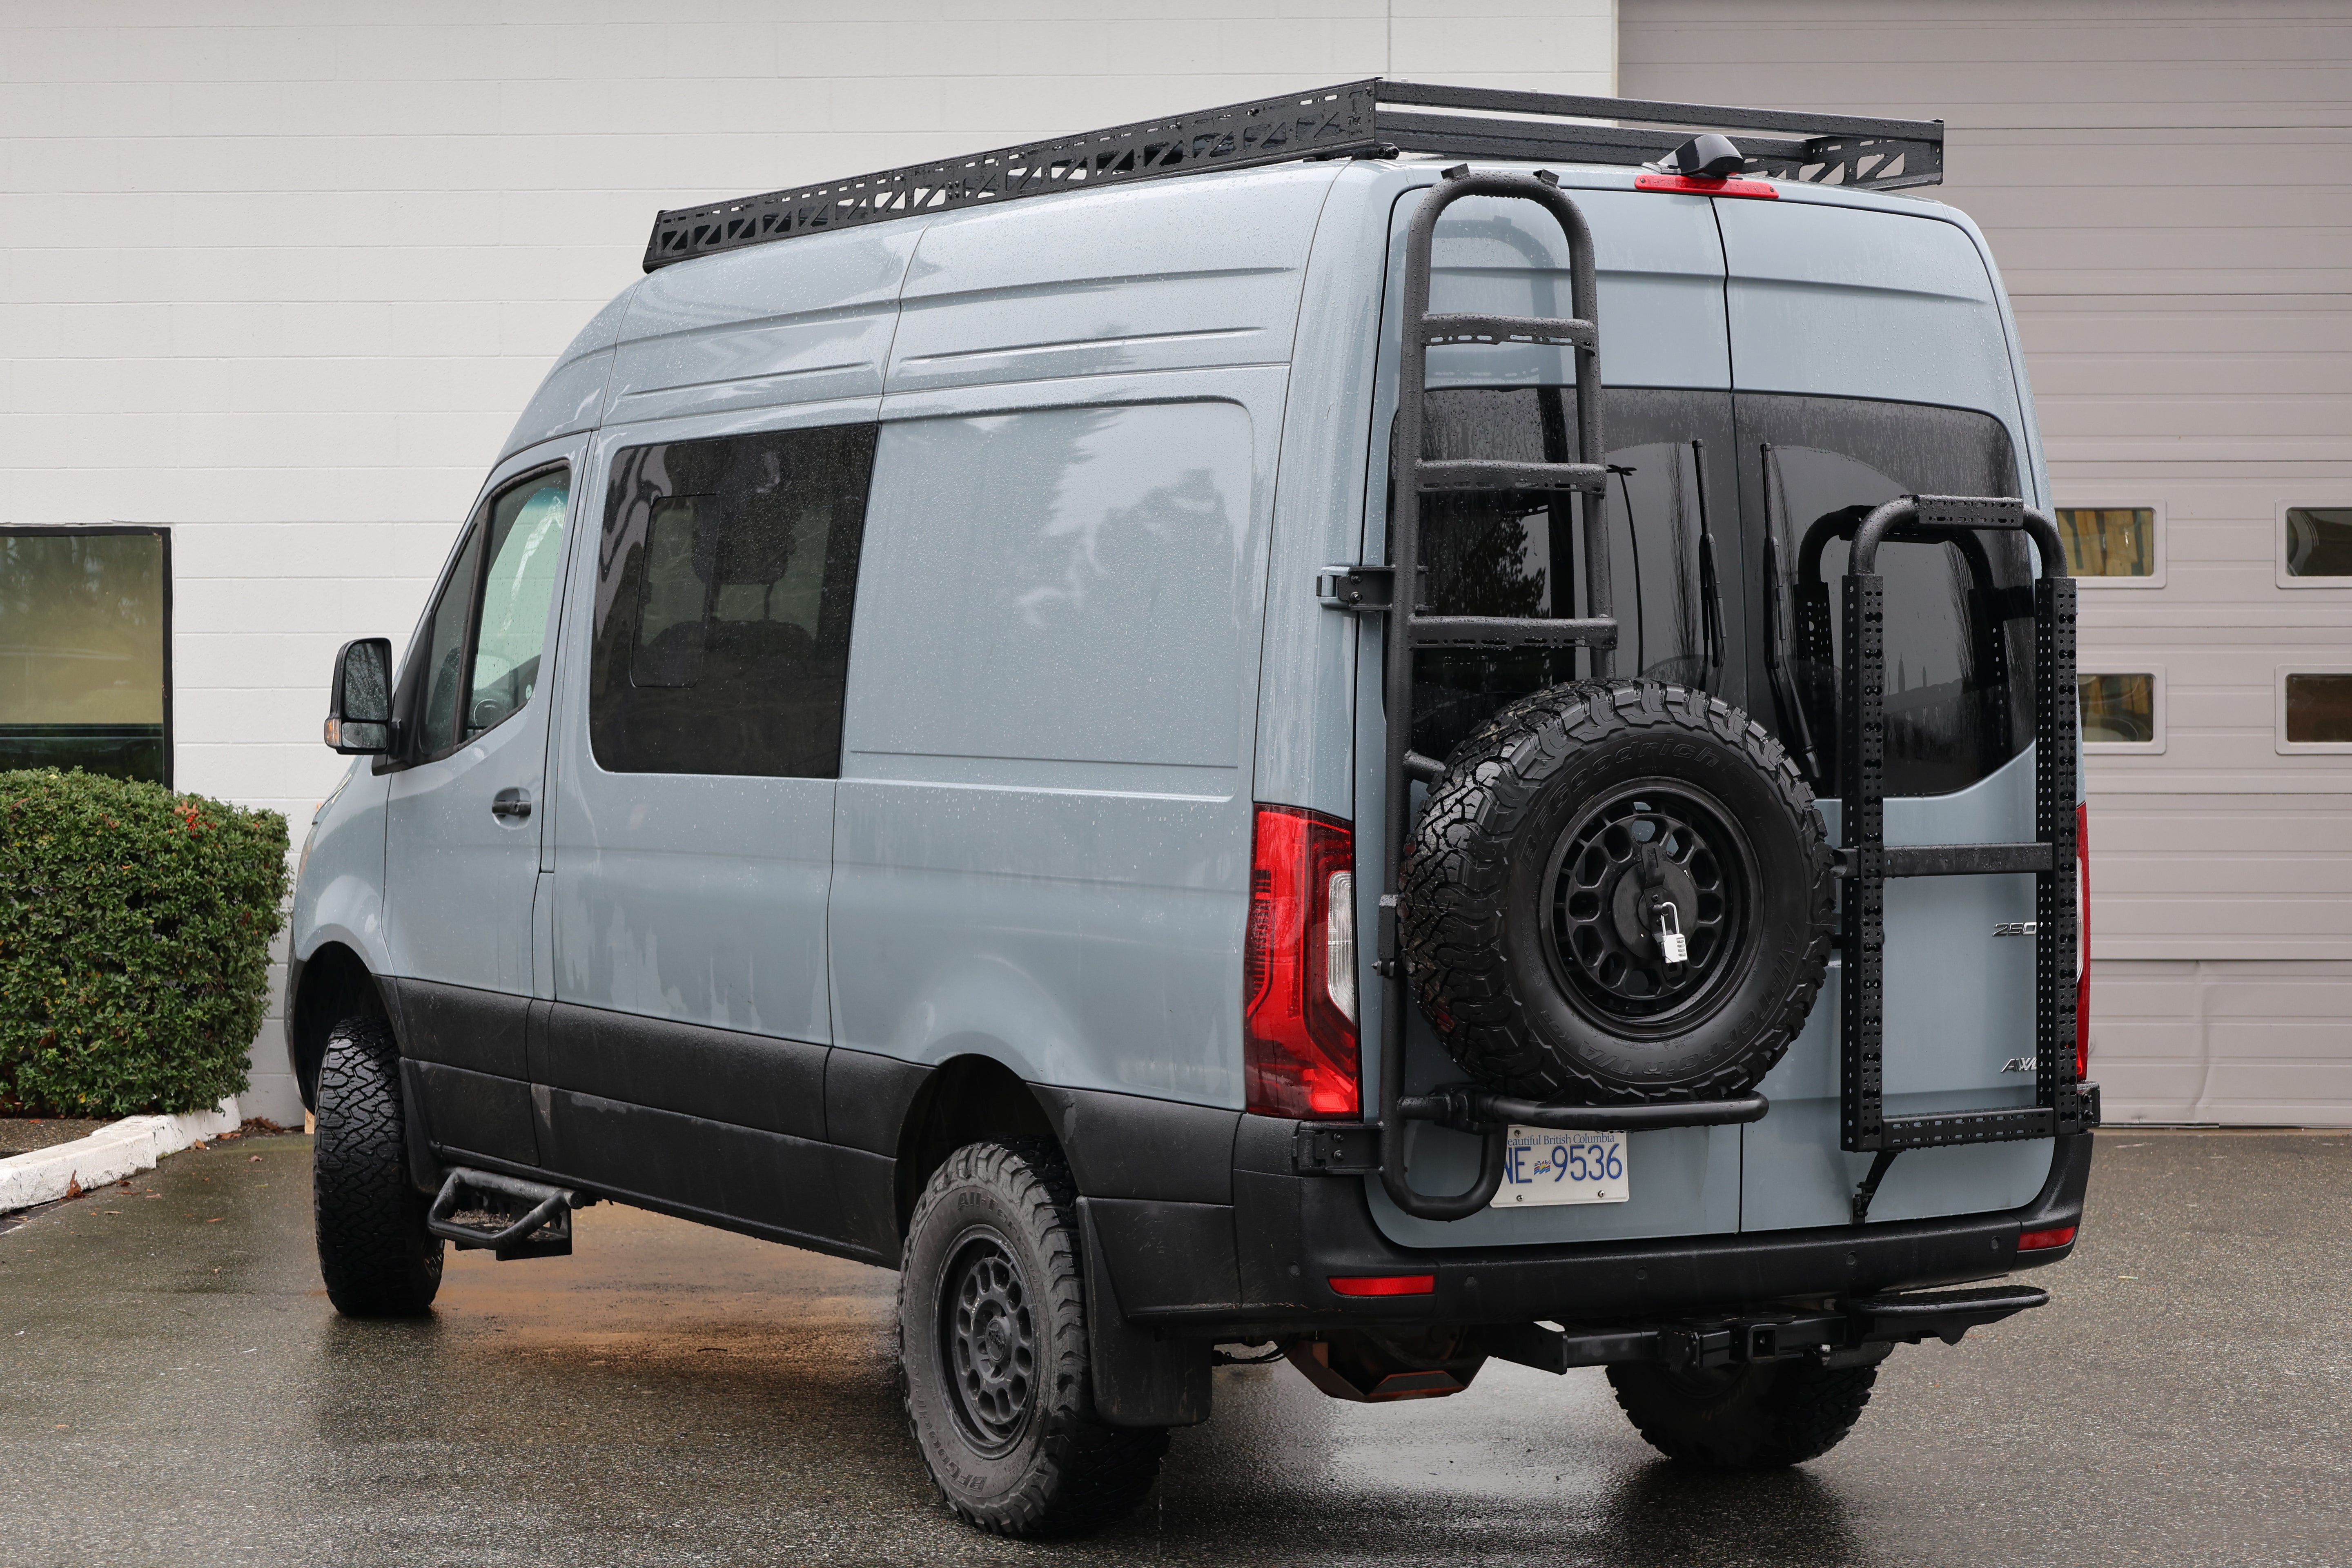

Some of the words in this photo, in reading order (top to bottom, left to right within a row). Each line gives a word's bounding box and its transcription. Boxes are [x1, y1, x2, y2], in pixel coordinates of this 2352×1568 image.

[1519, 739, 1721, 872] BFGoodrich
[1992, 922, 2036, 937] 250
[2000, 1057, 2036, 1074] AW
[1508, 1135, 1541, 1146] eautiful
[1544, 1134, 1571, 1145] British
[1573, 1133, 1615, 1144] Columbia
[1551, 1143, 1622, 1182] 9536
